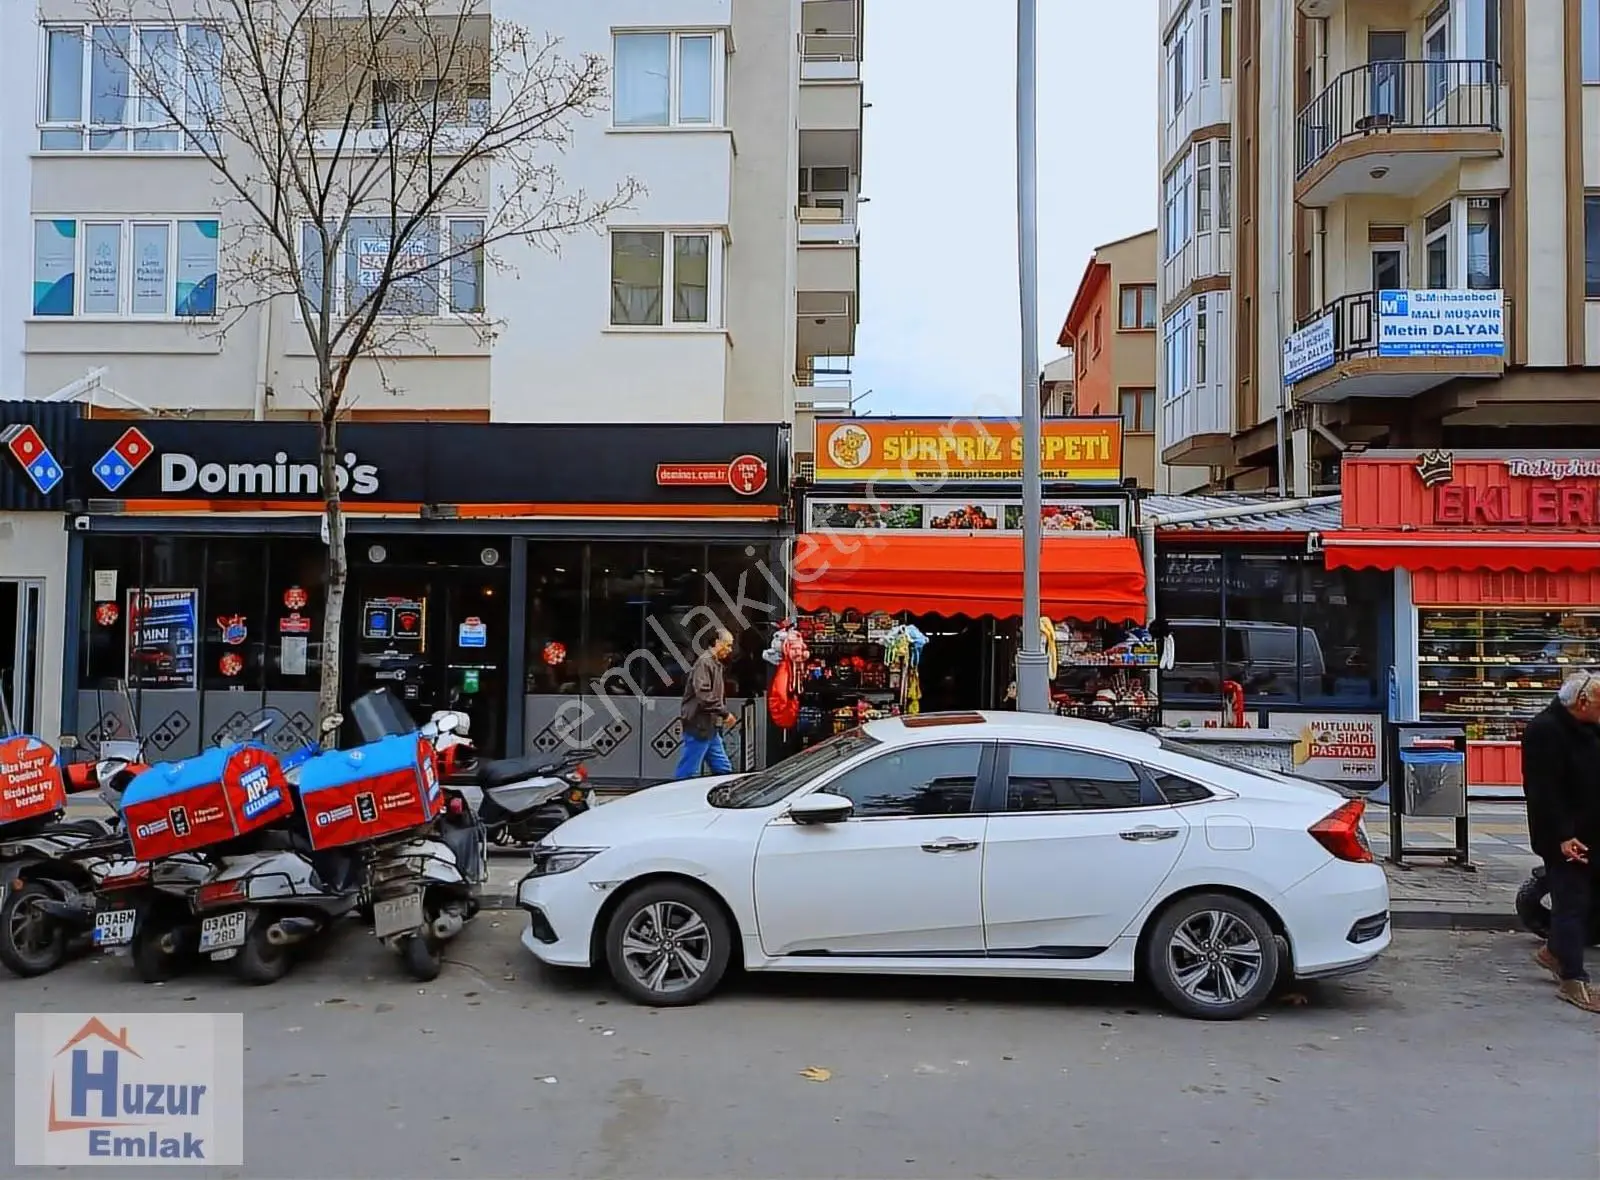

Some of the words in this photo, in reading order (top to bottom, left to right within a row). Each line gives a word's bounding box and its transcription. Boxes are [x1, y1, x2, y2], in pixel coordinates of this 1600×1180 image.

[1384, 324, 1427, 336] Metin
[1433, 324, 1499, 336] DALYAN
[884, 429, 1002, 460] SÜRPRİZ
[1011, 429, 1109, 460] SPETİ
[916, 469, 1068, 480] www.surprizsepetm.tr
[1311, 722, 1373, 731] MUTLULUK
[1311, 745, 1374, 756] PASTADA!
[247, 777, 269, 802] APP
